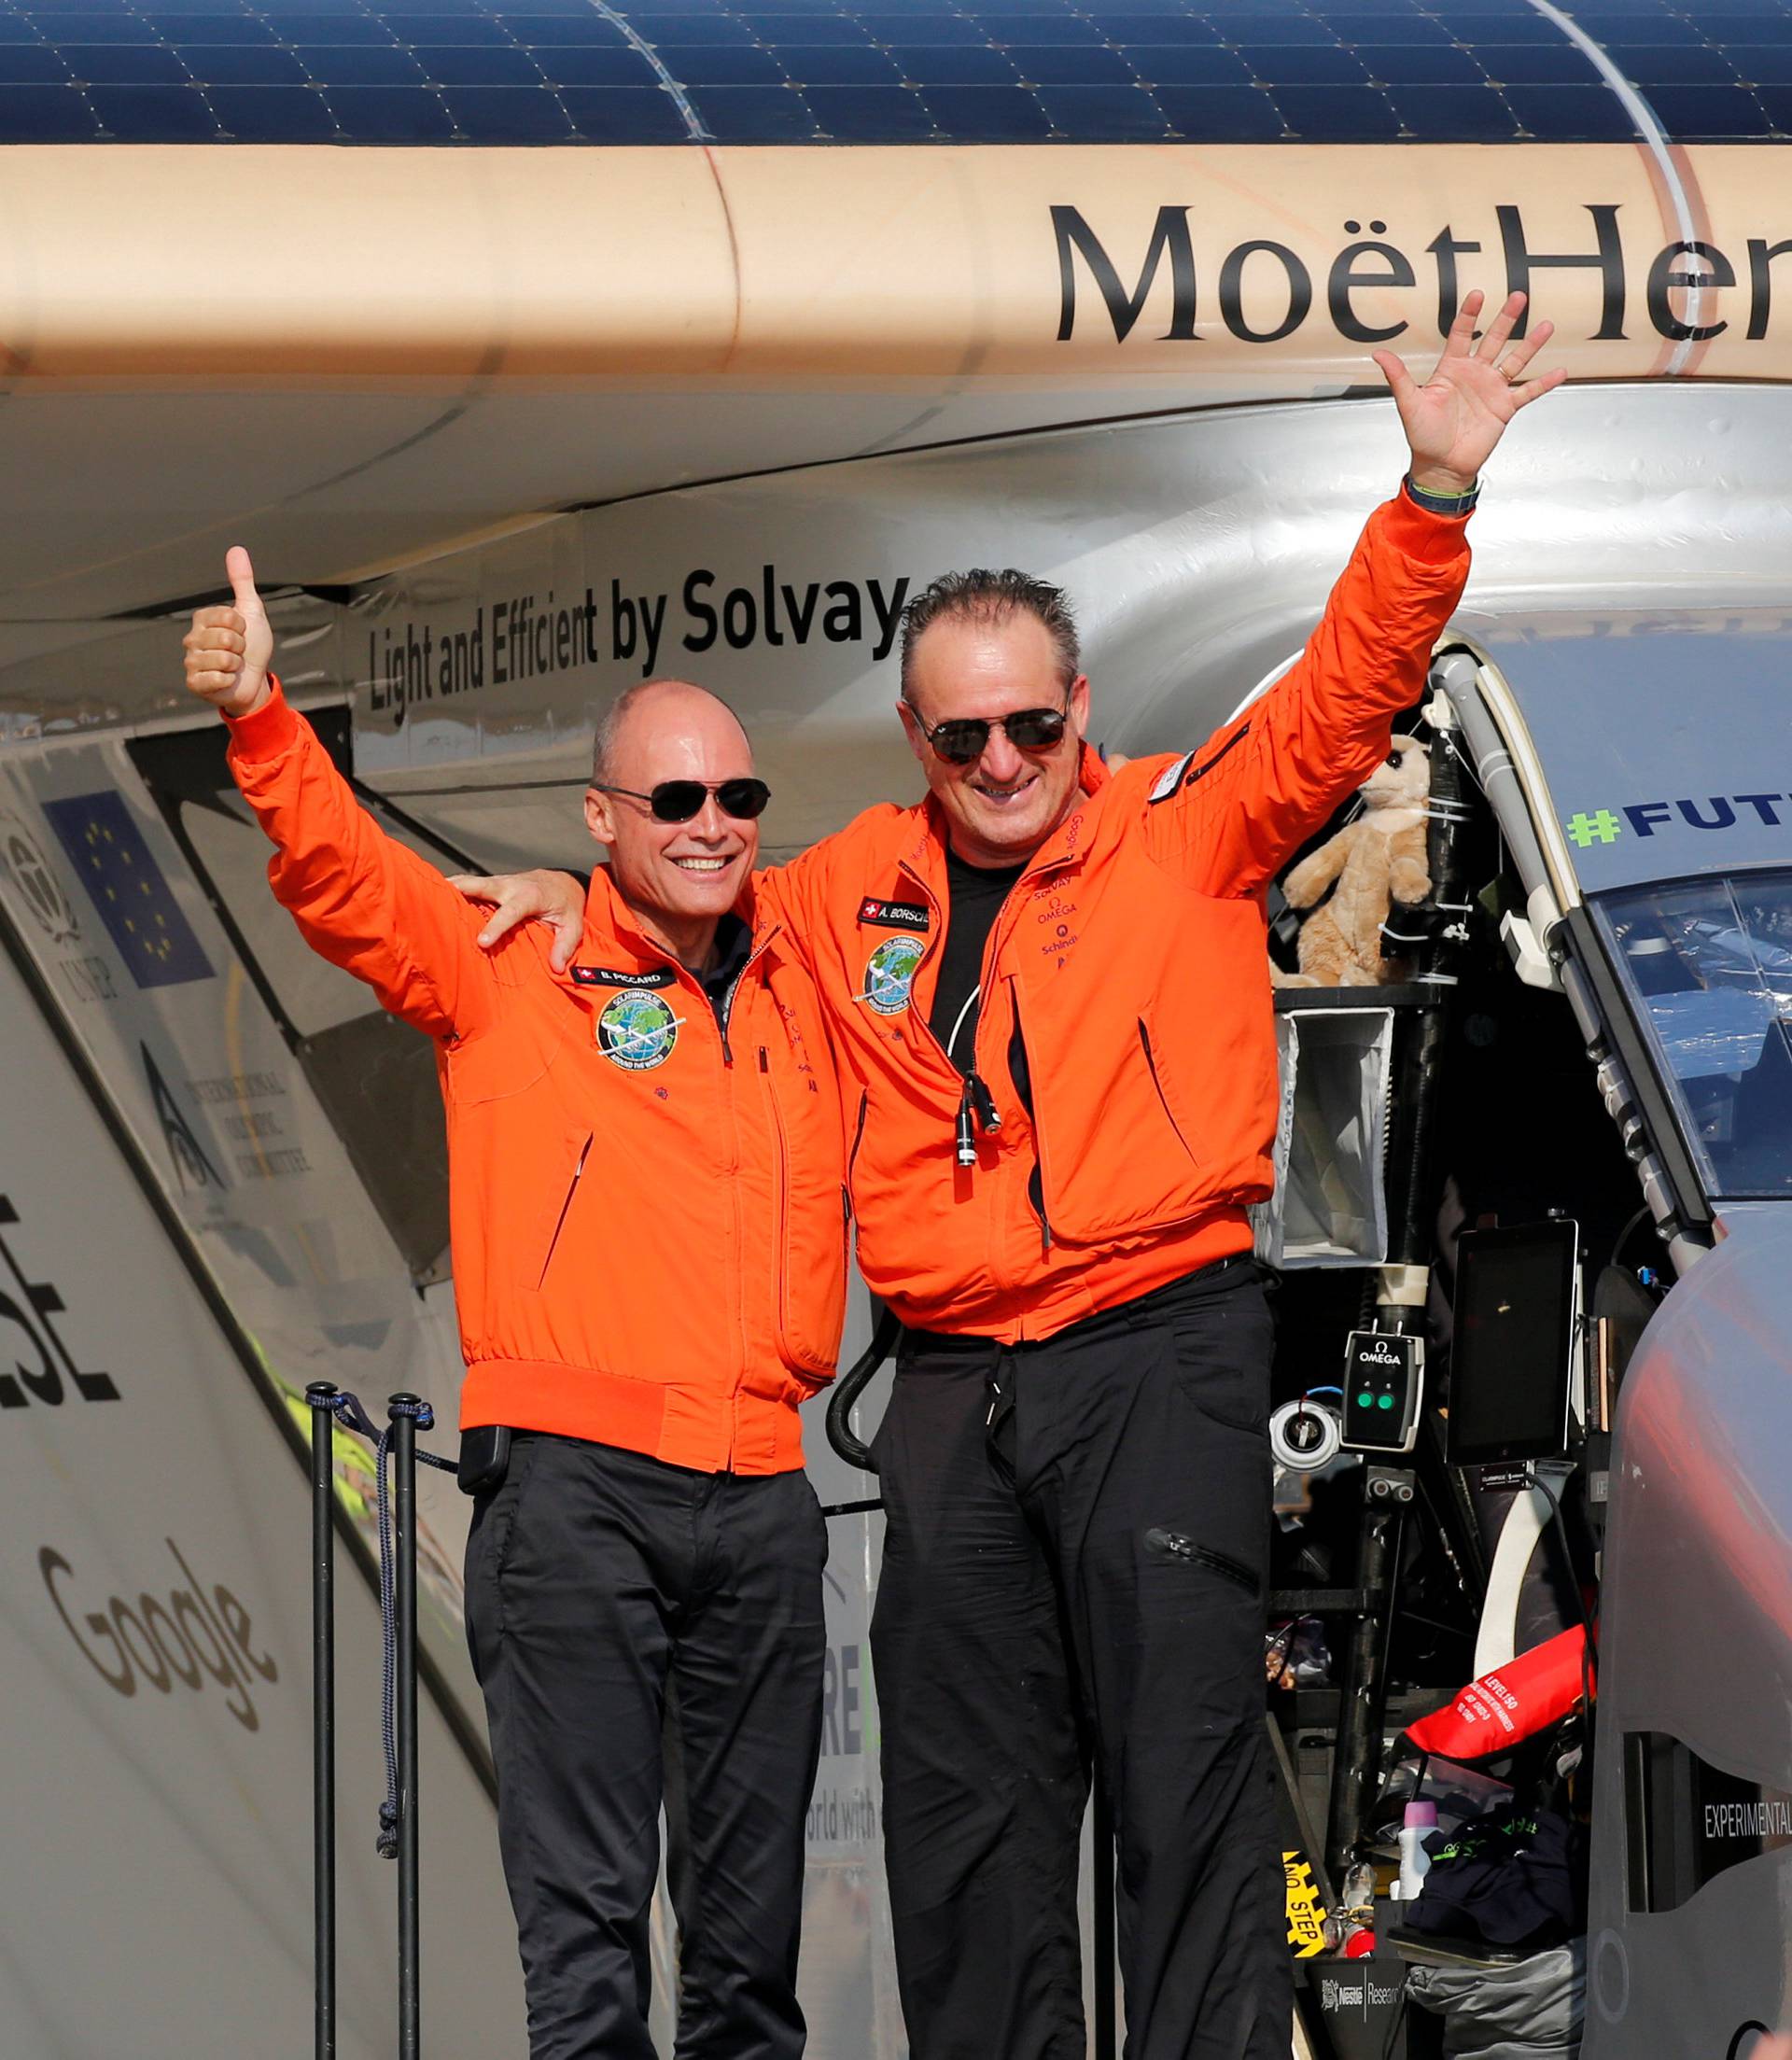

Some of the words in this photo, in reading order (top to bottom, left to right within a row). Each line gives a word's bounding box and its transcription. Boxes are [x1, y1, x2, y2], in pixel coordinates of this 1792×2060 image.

[370, 624, 432, 727] Light
[439, 608, 483, 696] and
[492, 588, 598, 684] Efficient
[611, 579, 667, 678] by
[681, 565, 910, 661] Solvay
[1566, 792, 1792, 848] #FUT
[1038, 904, 1077, 924] OMEGA
[600, 971, 611, 979] B.
[1359, 1352, 1401, 1365] OMEGA
[38, 1535, 278, 1732] Google
[1704, 1801, 1792, 1838] EXPERIMENTAL
[1291, 1901, 1319, 1940] STEP
[1367, 1983, 1405, 2005] Resear
